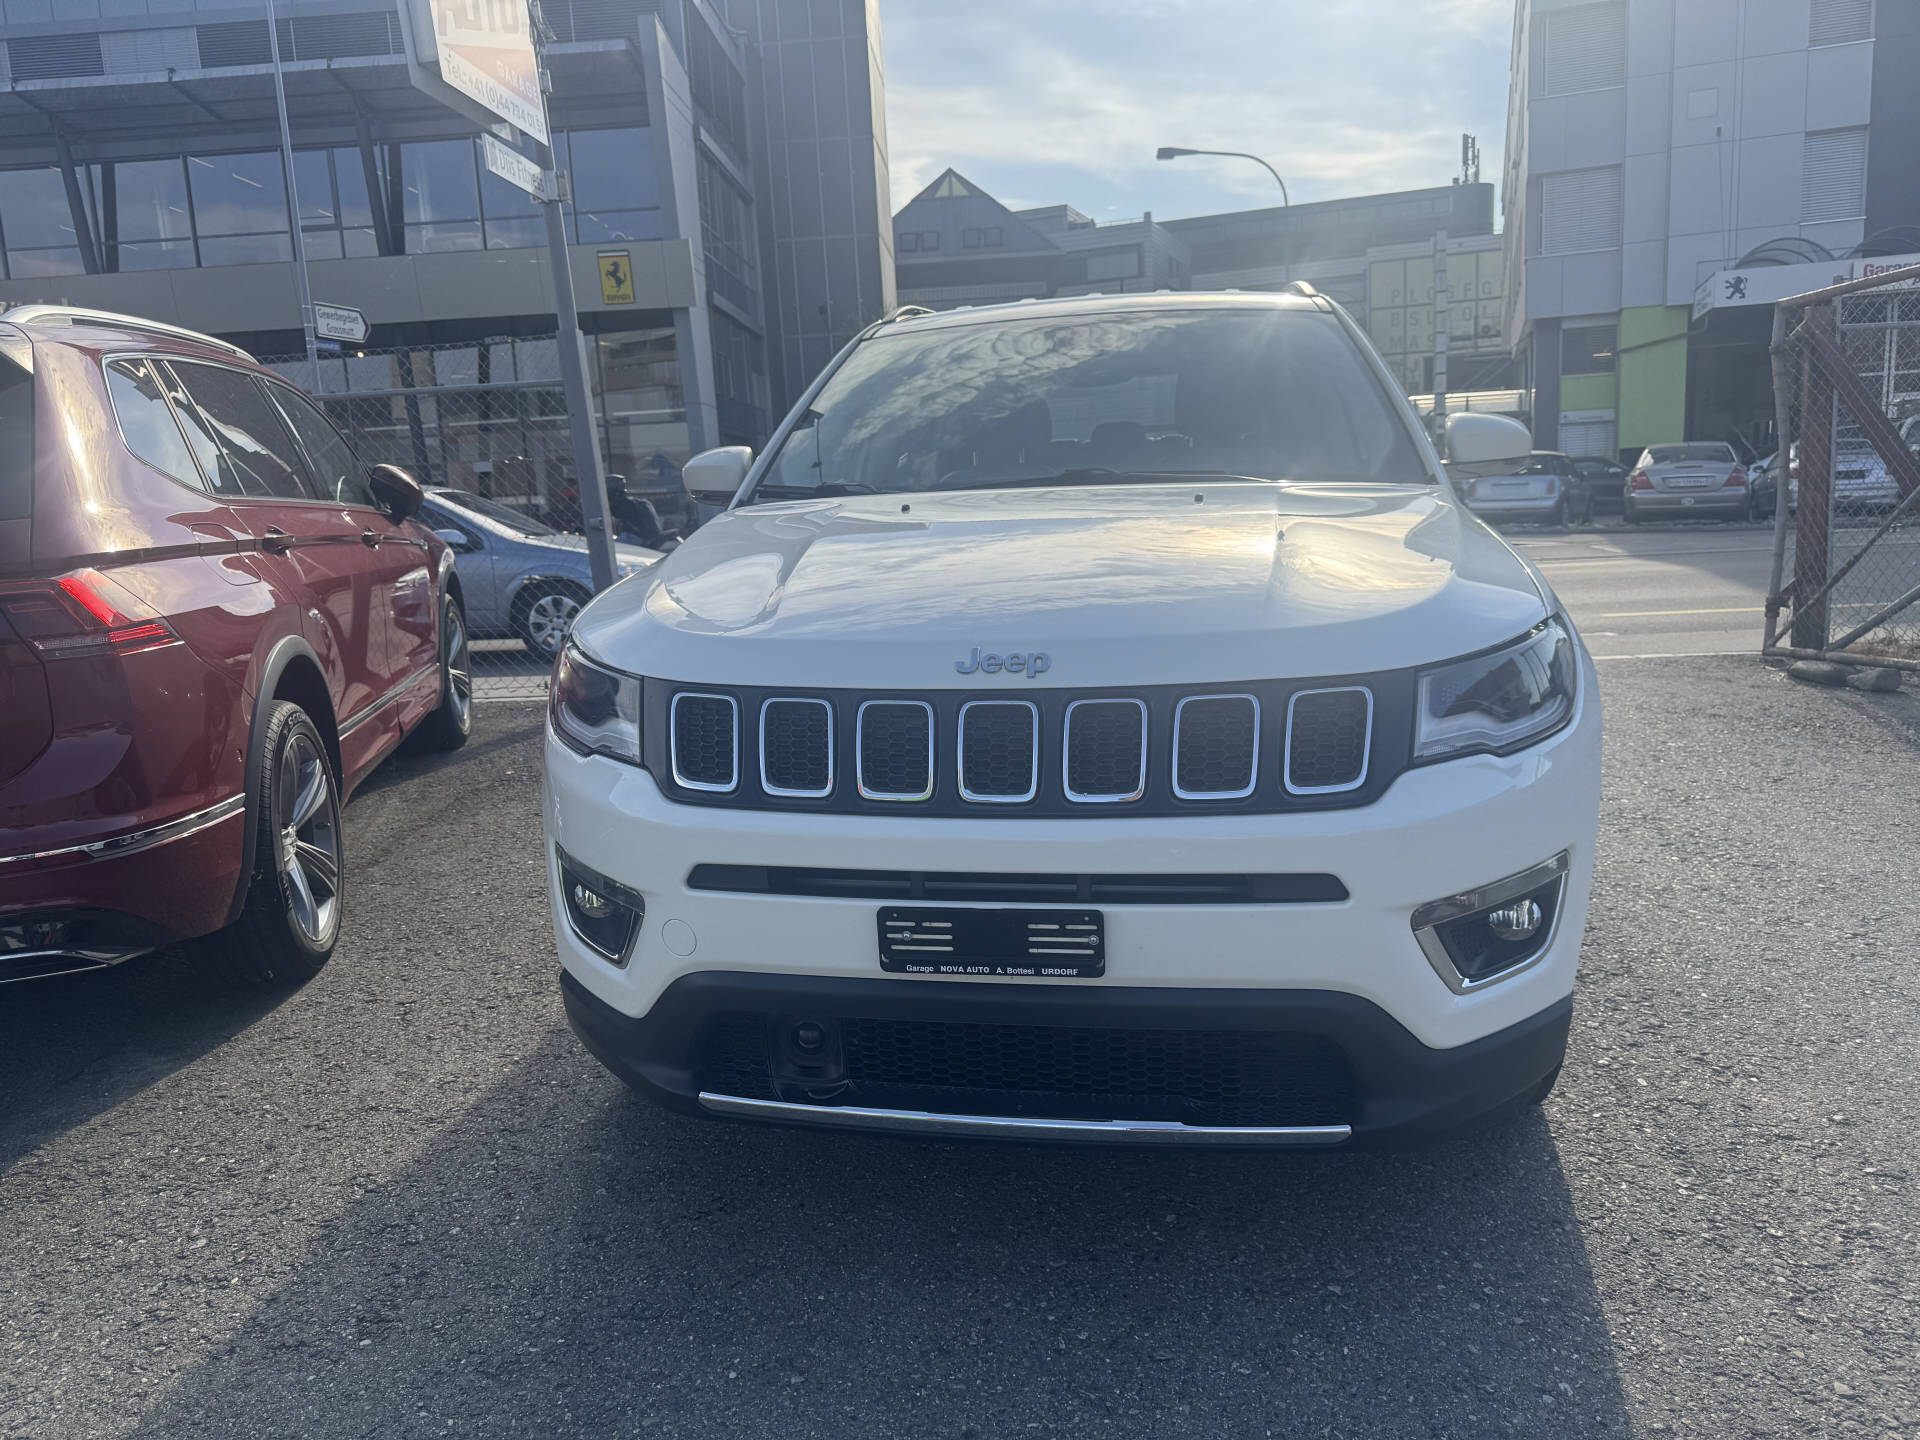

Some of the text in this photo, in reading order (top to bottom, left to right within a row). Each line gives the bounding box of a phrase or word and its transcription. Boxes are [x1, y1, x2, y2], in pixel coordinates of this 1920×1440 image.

[954, 647, 1051, 679] Jeep
[906, 964, 935, 973] Garage
[940, 965, 964, 973] NOVA
[966, 966, 990, 974] AUTO
[1006, 967, 1035, 975] Bottesi
[1041, 968, 1079, 976] URDORF
